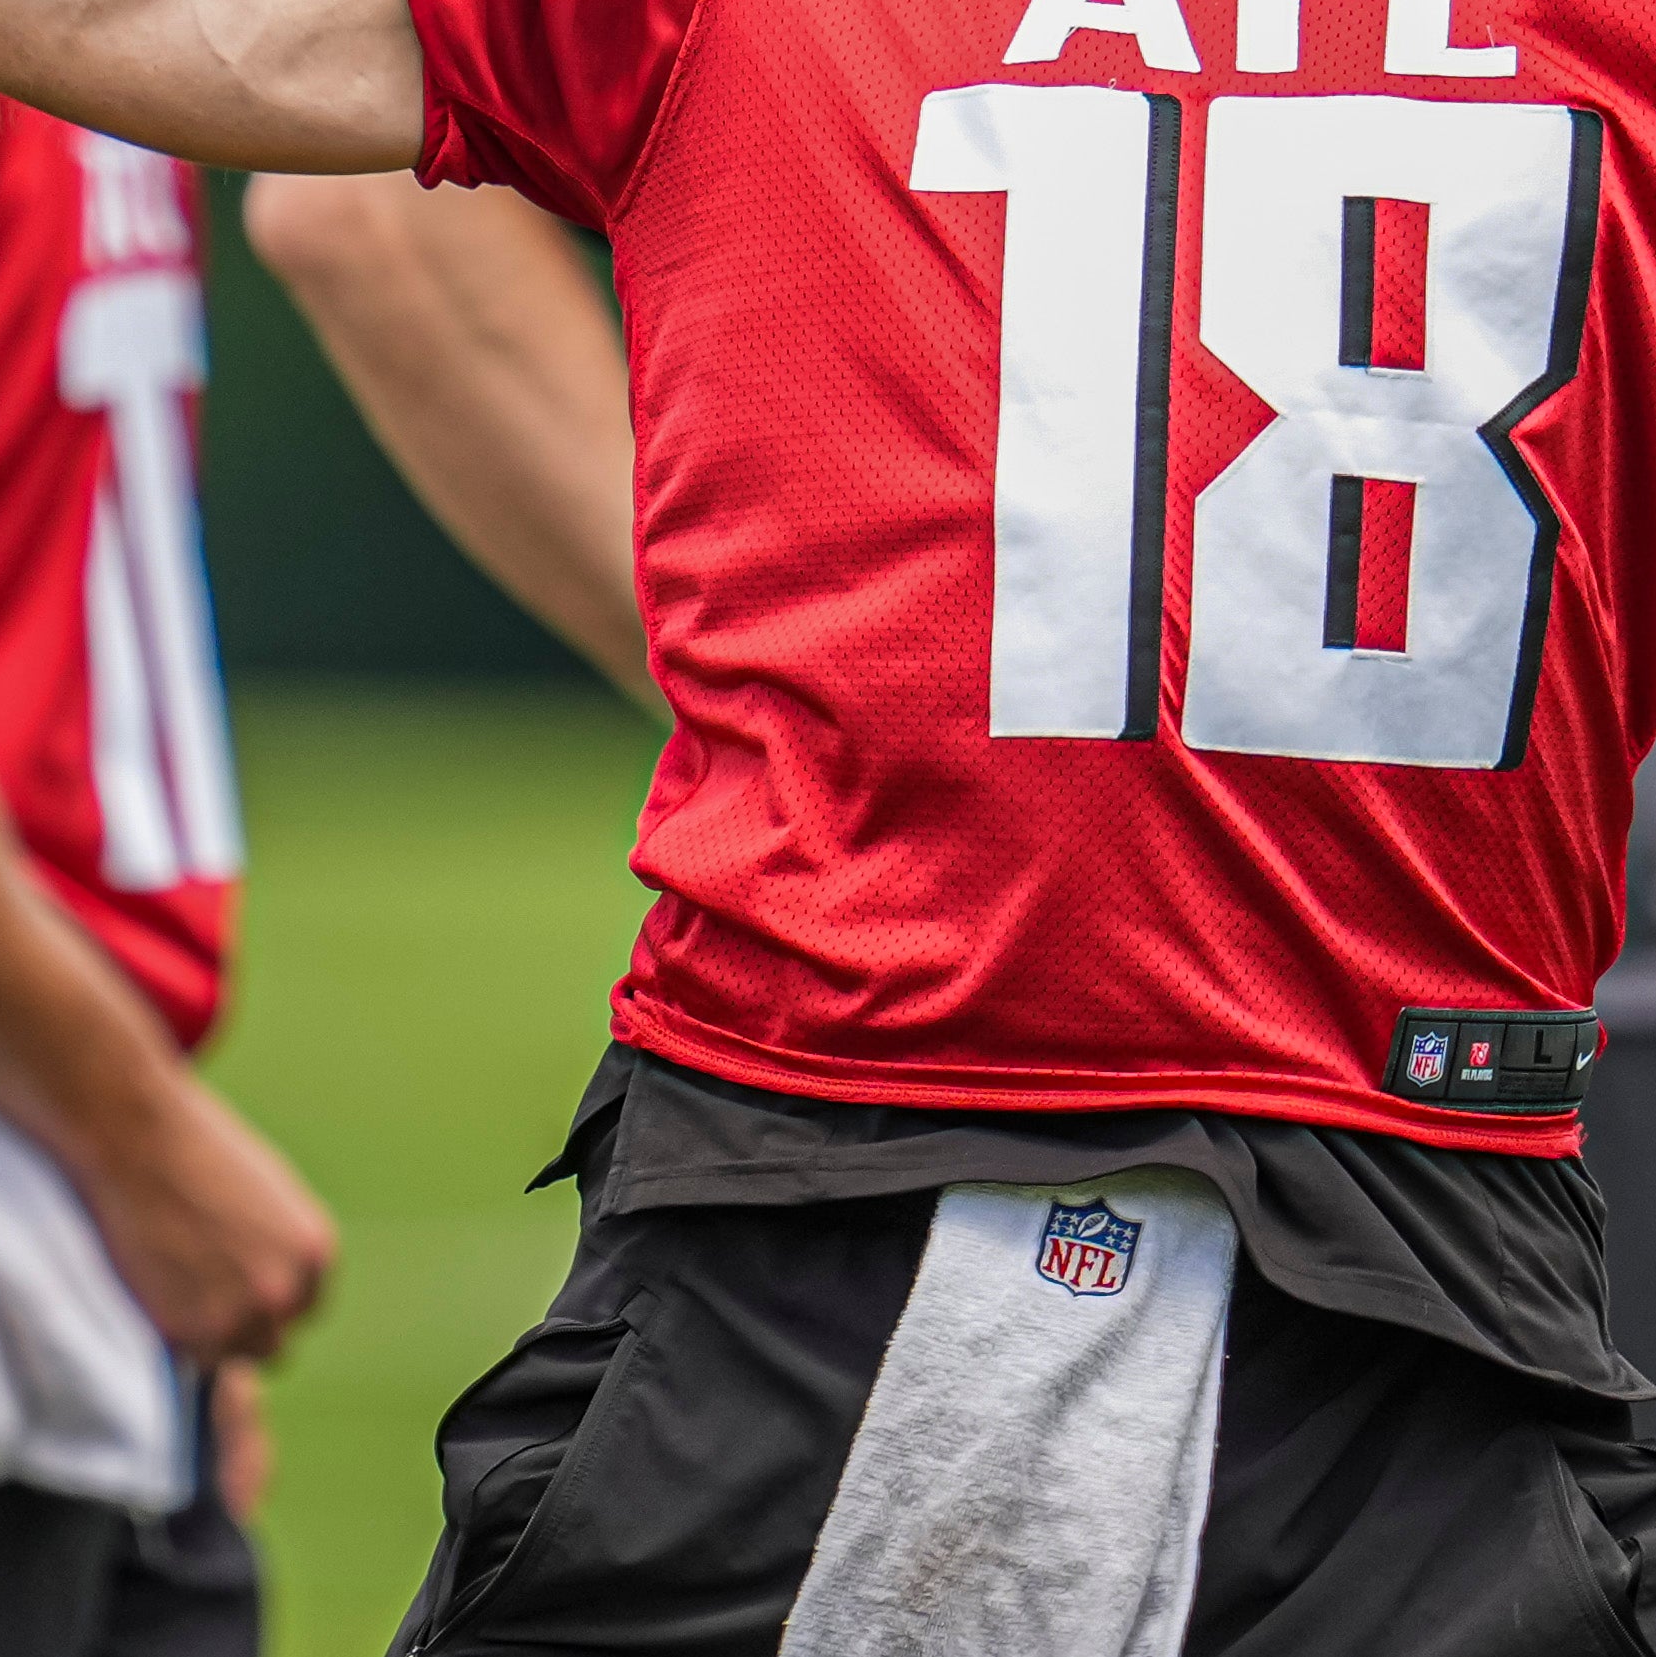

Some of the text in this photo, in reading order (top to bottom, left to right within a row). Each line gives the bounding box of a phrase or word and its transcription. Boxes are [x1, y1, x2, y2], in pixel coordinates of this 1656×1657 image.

[909, 82, 1603, 772] 18
[1411, 1055, 1439, 1078] NFL
[1533, 1029, 1552, 1065] L
[1043, 1237, 1117, 1289] NFL
